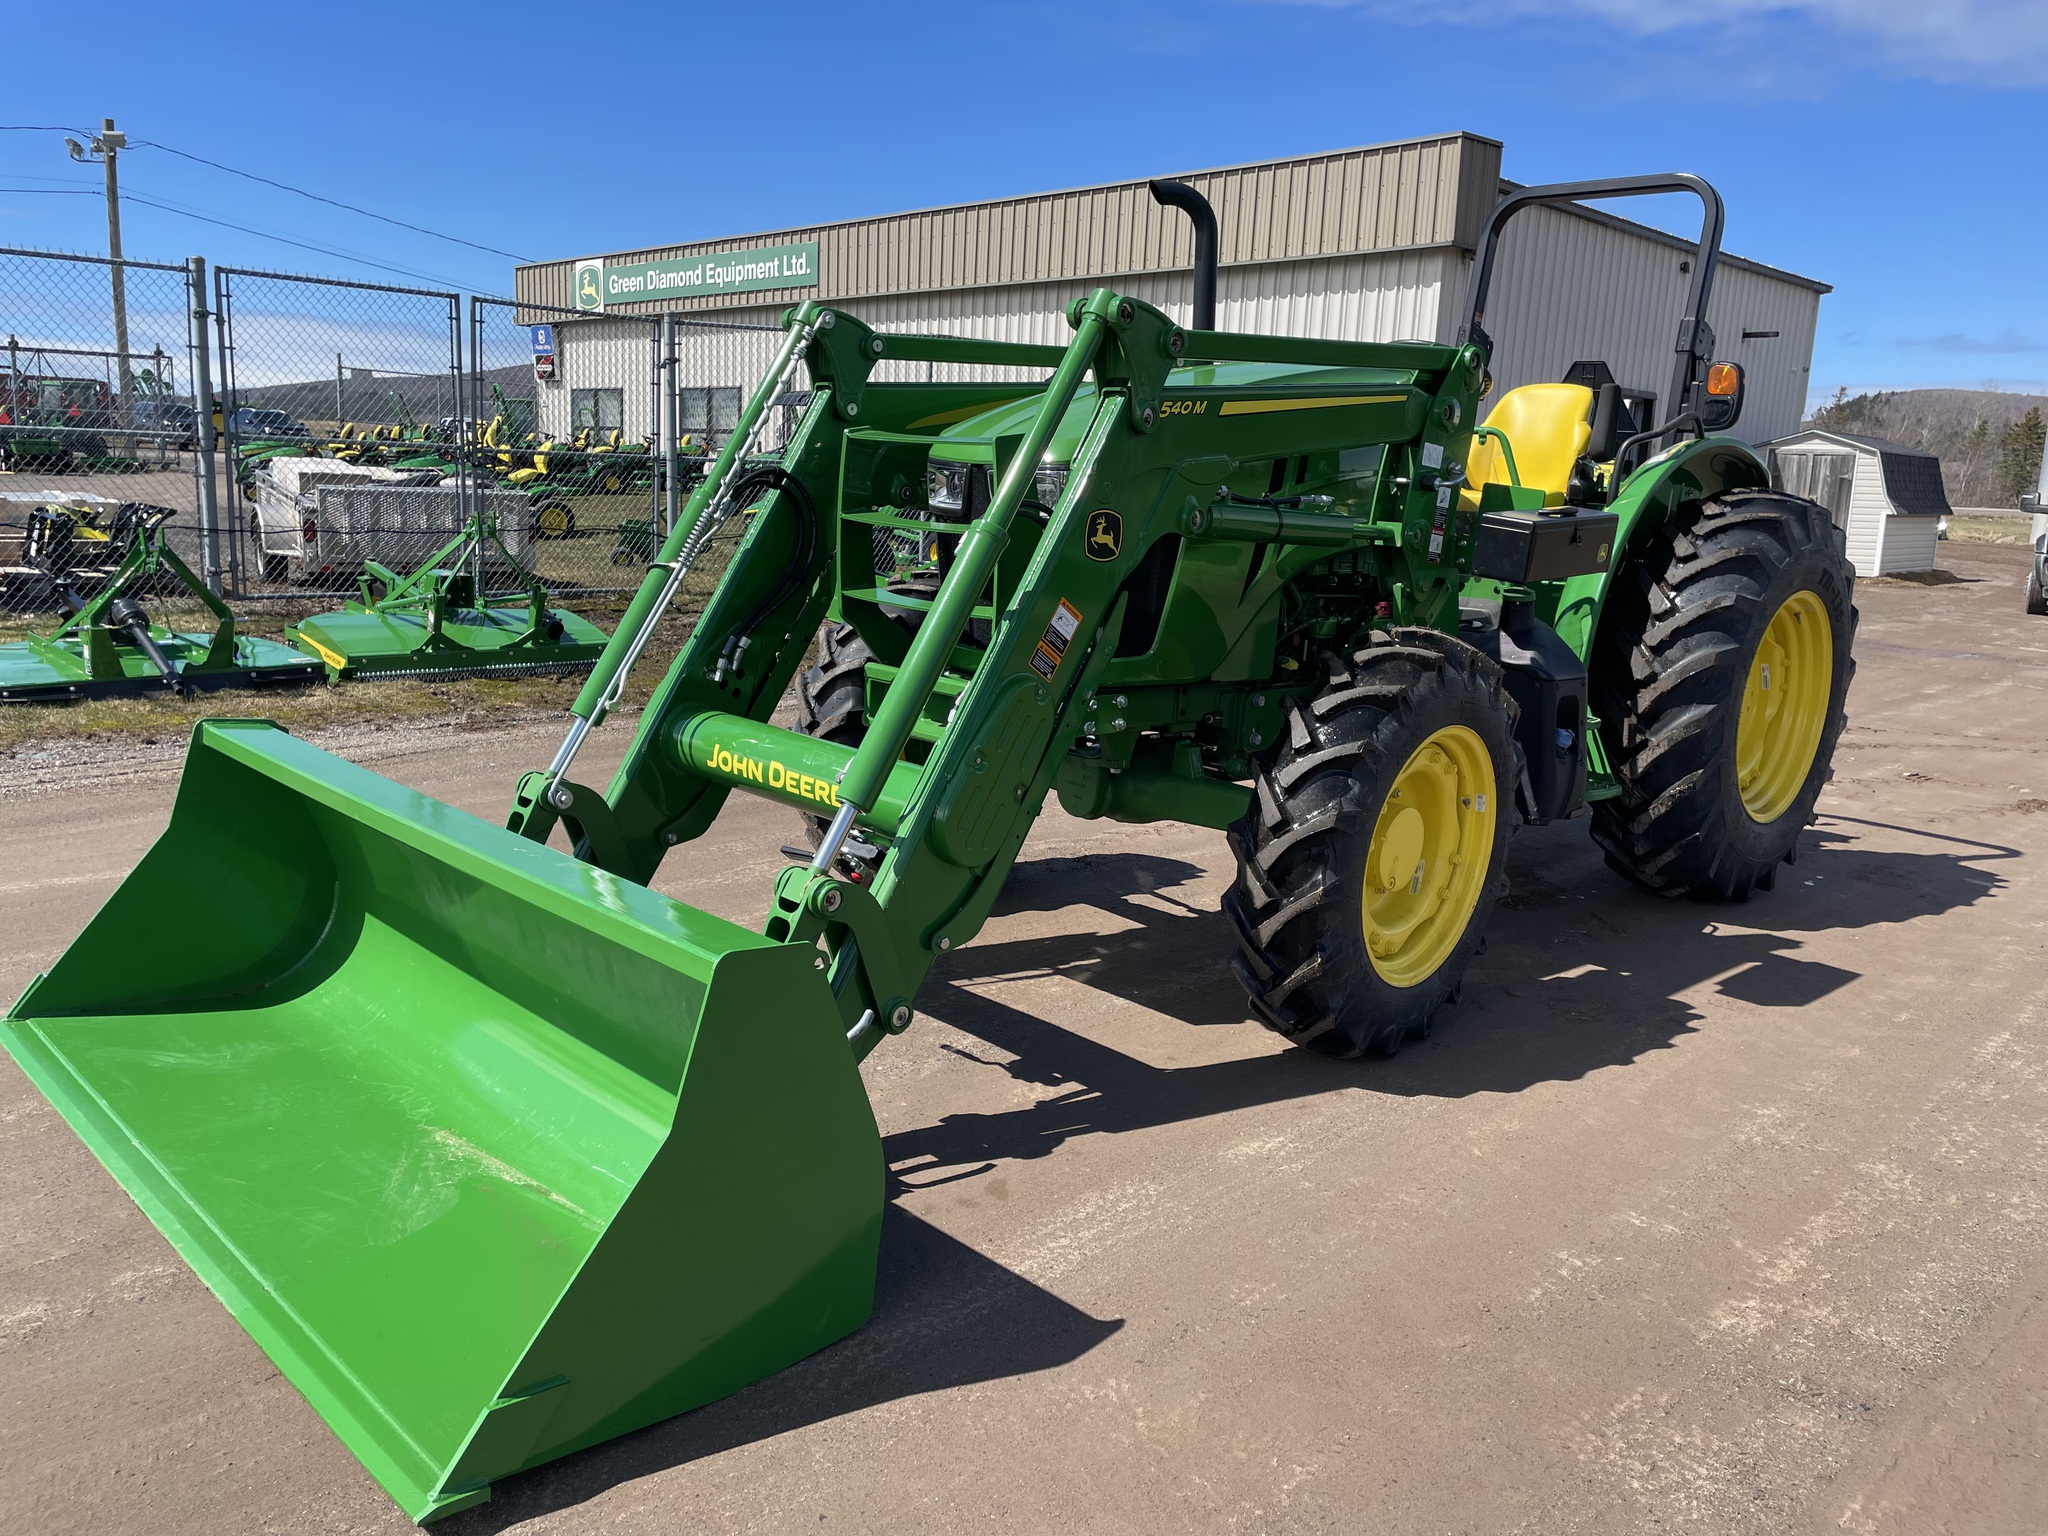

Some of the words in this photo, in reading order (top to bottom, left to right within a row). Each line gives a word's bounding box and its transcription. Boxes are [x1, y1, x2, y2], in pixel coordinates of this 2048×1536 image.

[609, 274, 644, 295] Green
[647, 263, 702, 291] Diamond
[706, 257, 779, 287] Equipment
[783, 251, 811, 277] Ltd.
[706, 743, 763, 783] JOHN
